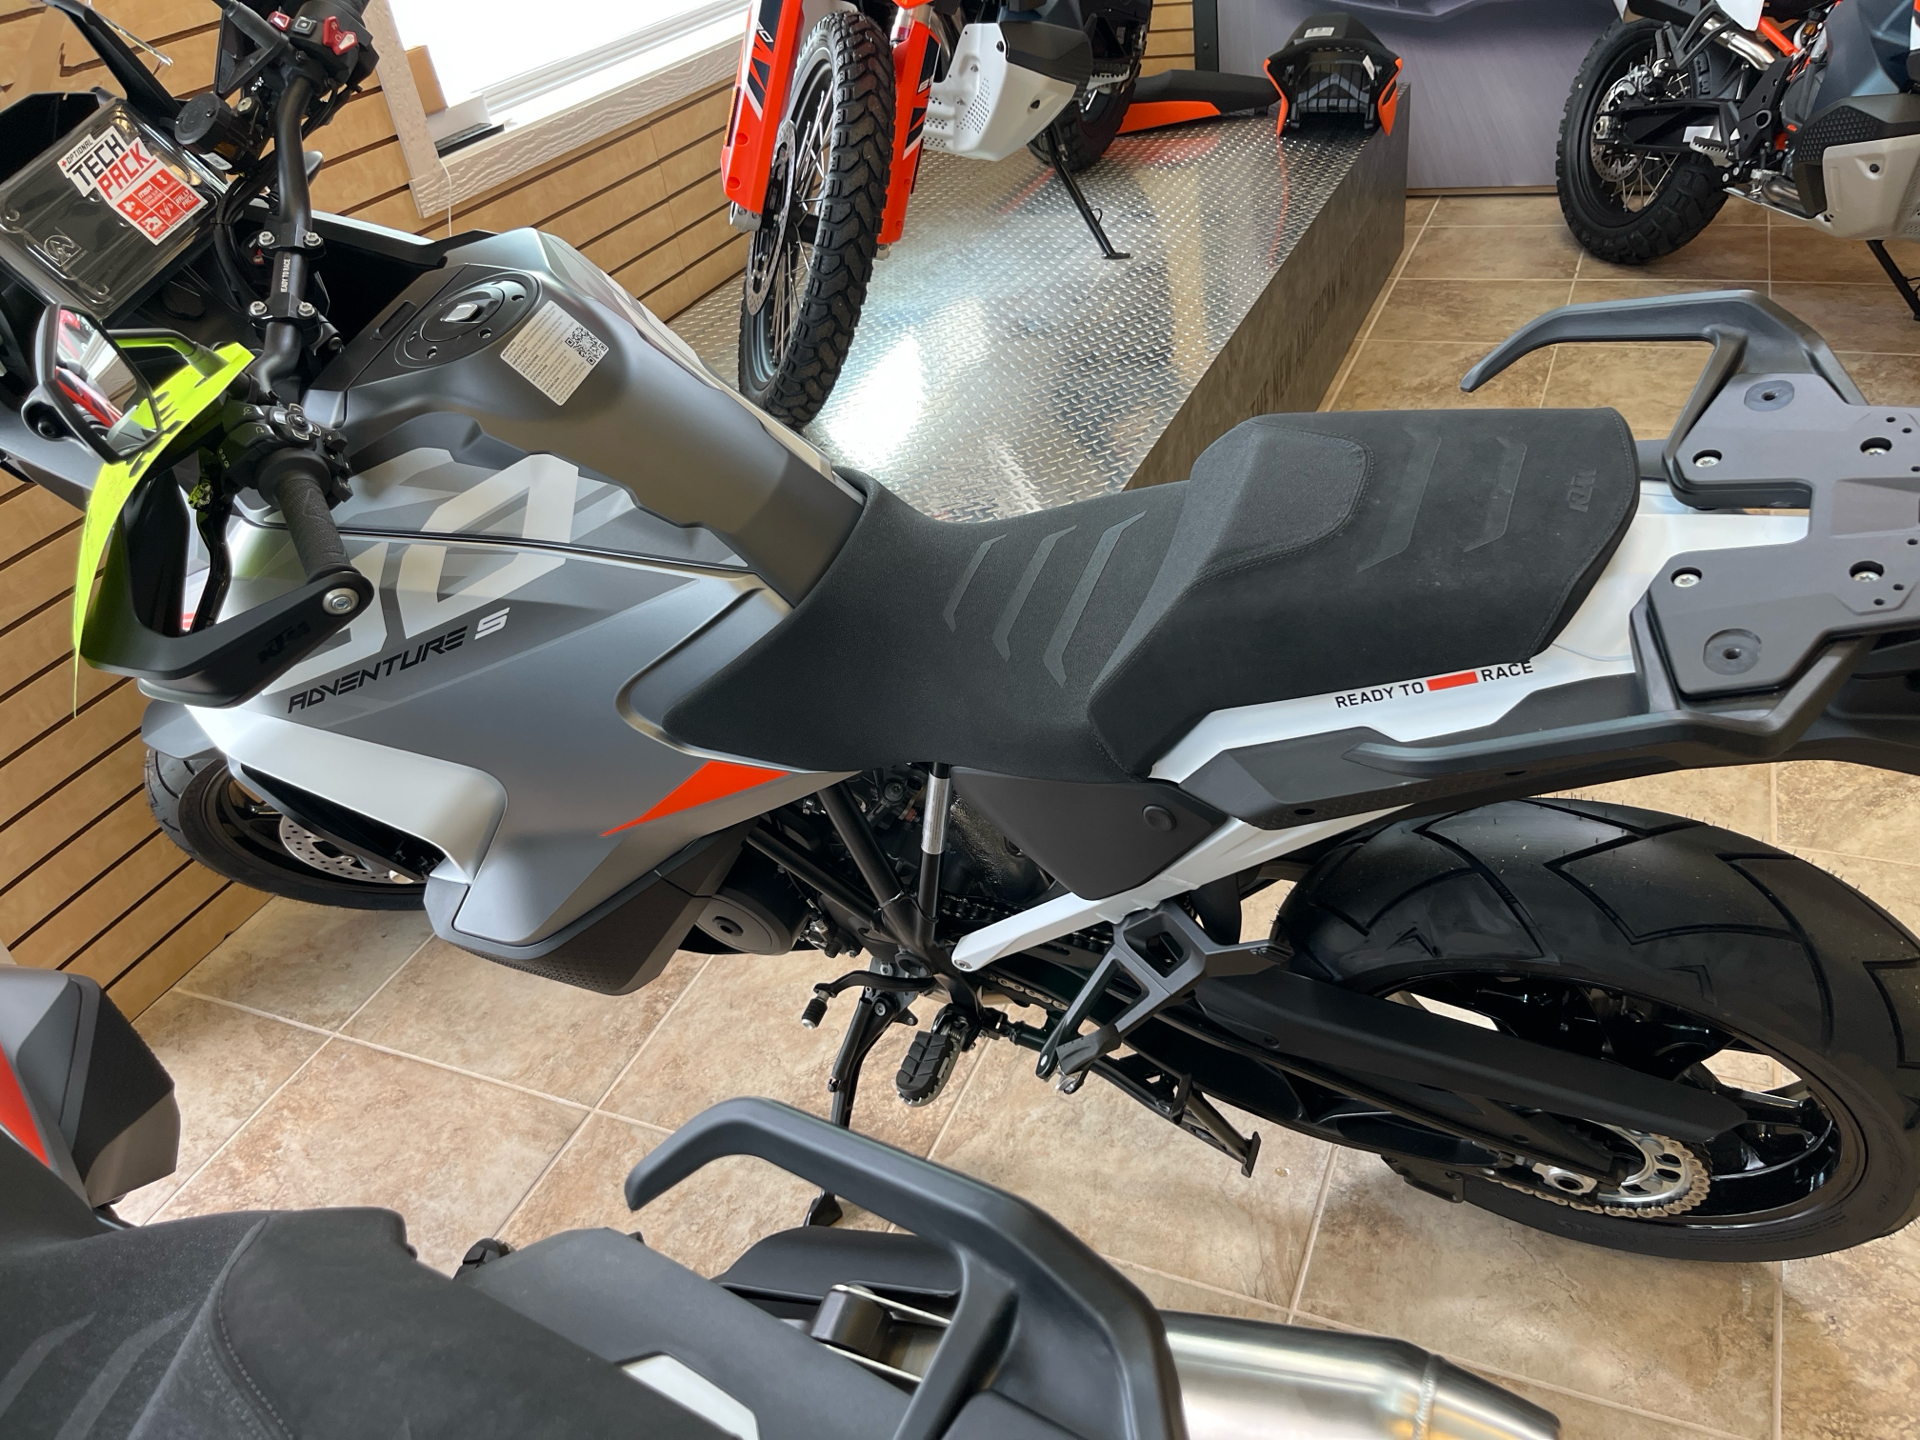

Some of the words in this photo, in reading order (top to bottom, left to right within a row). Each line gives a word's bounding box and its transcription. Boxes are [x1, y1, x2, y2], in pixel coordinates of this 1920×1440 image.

[72, 134, 126, 186] TECH
[98, 142, 150, 200] PACK
[288, 626, 468, 714] ADVENTURE
[474, 607, 510, 640] S
[1334, 687, 1394, 708] READY
[1399, 682, 1424, 696] TO
[1480, 660, 1534, 682] RACE
